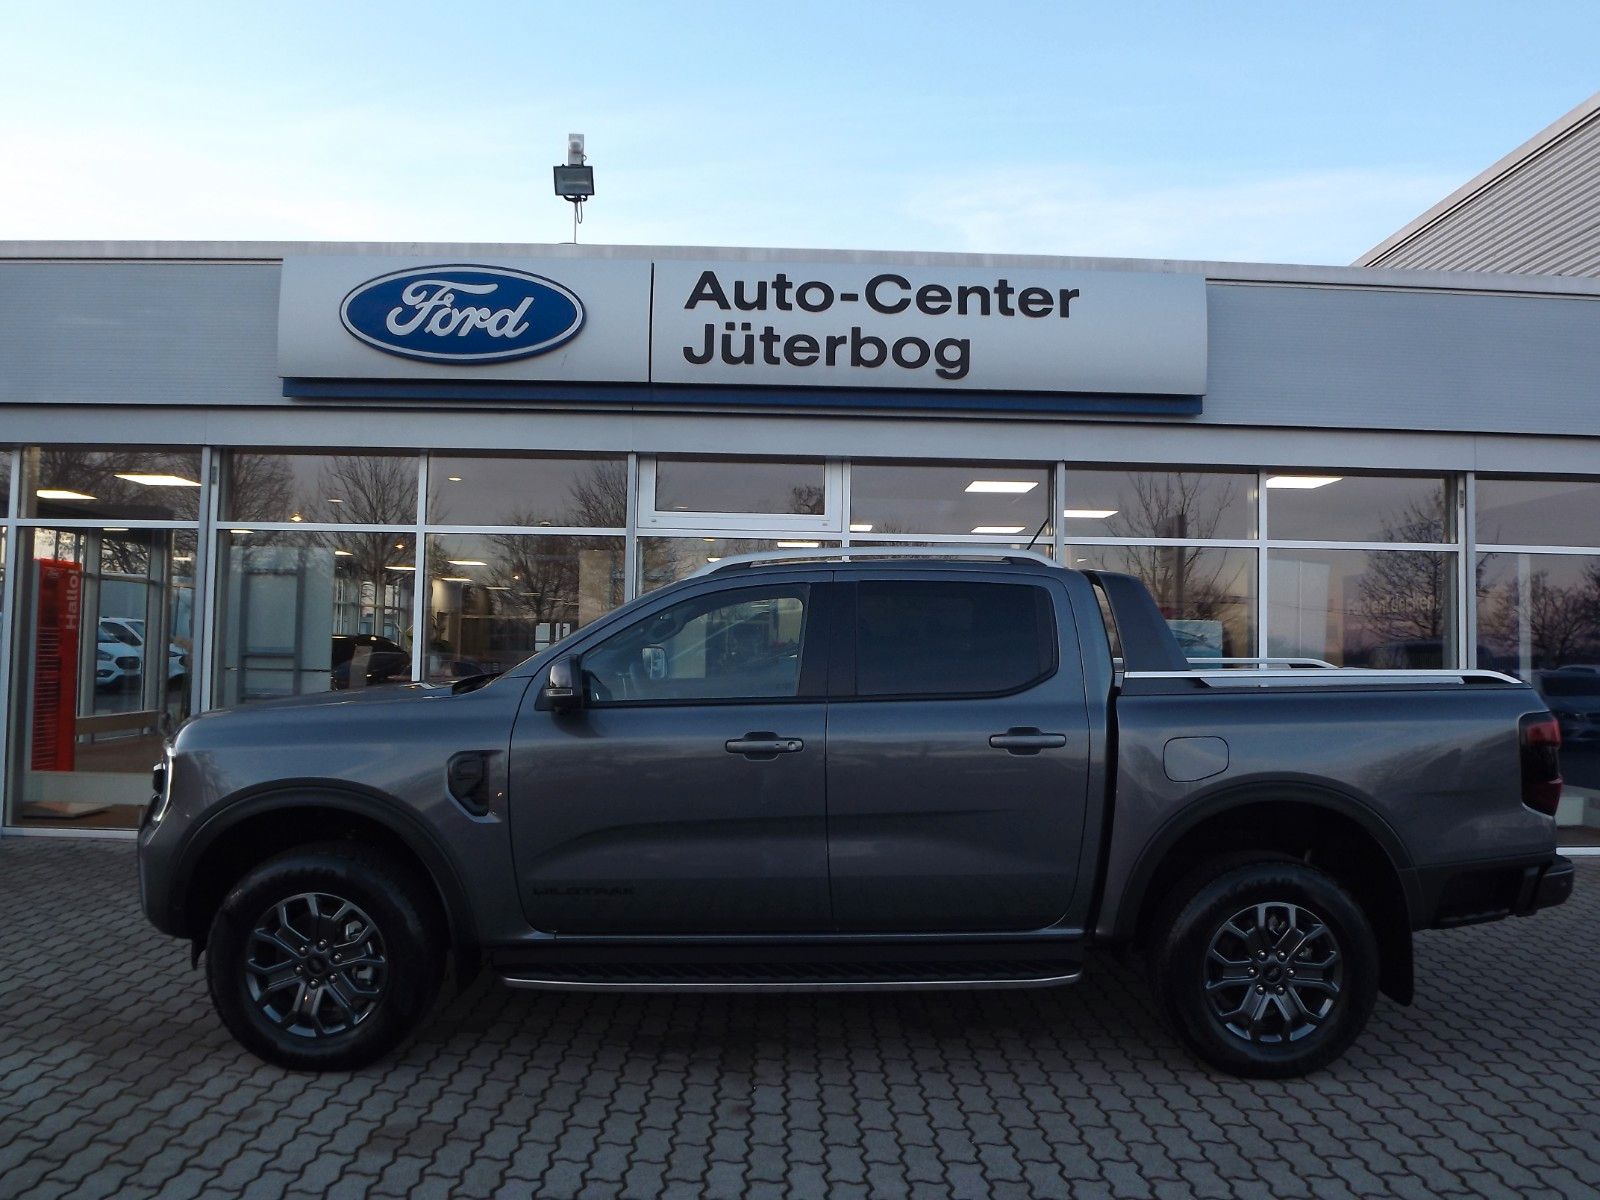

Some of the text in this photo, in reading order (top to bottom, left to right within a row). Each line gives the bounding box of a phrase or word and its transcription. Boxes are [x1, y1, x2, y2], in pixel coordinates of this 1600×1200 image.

[385, 279, 535, 339] Ford
[683, 270, 1080, 319] Auto-Center
[683, 322, 972, 381] Jüterbog
[65, 569, 79, 630] Hallo!
